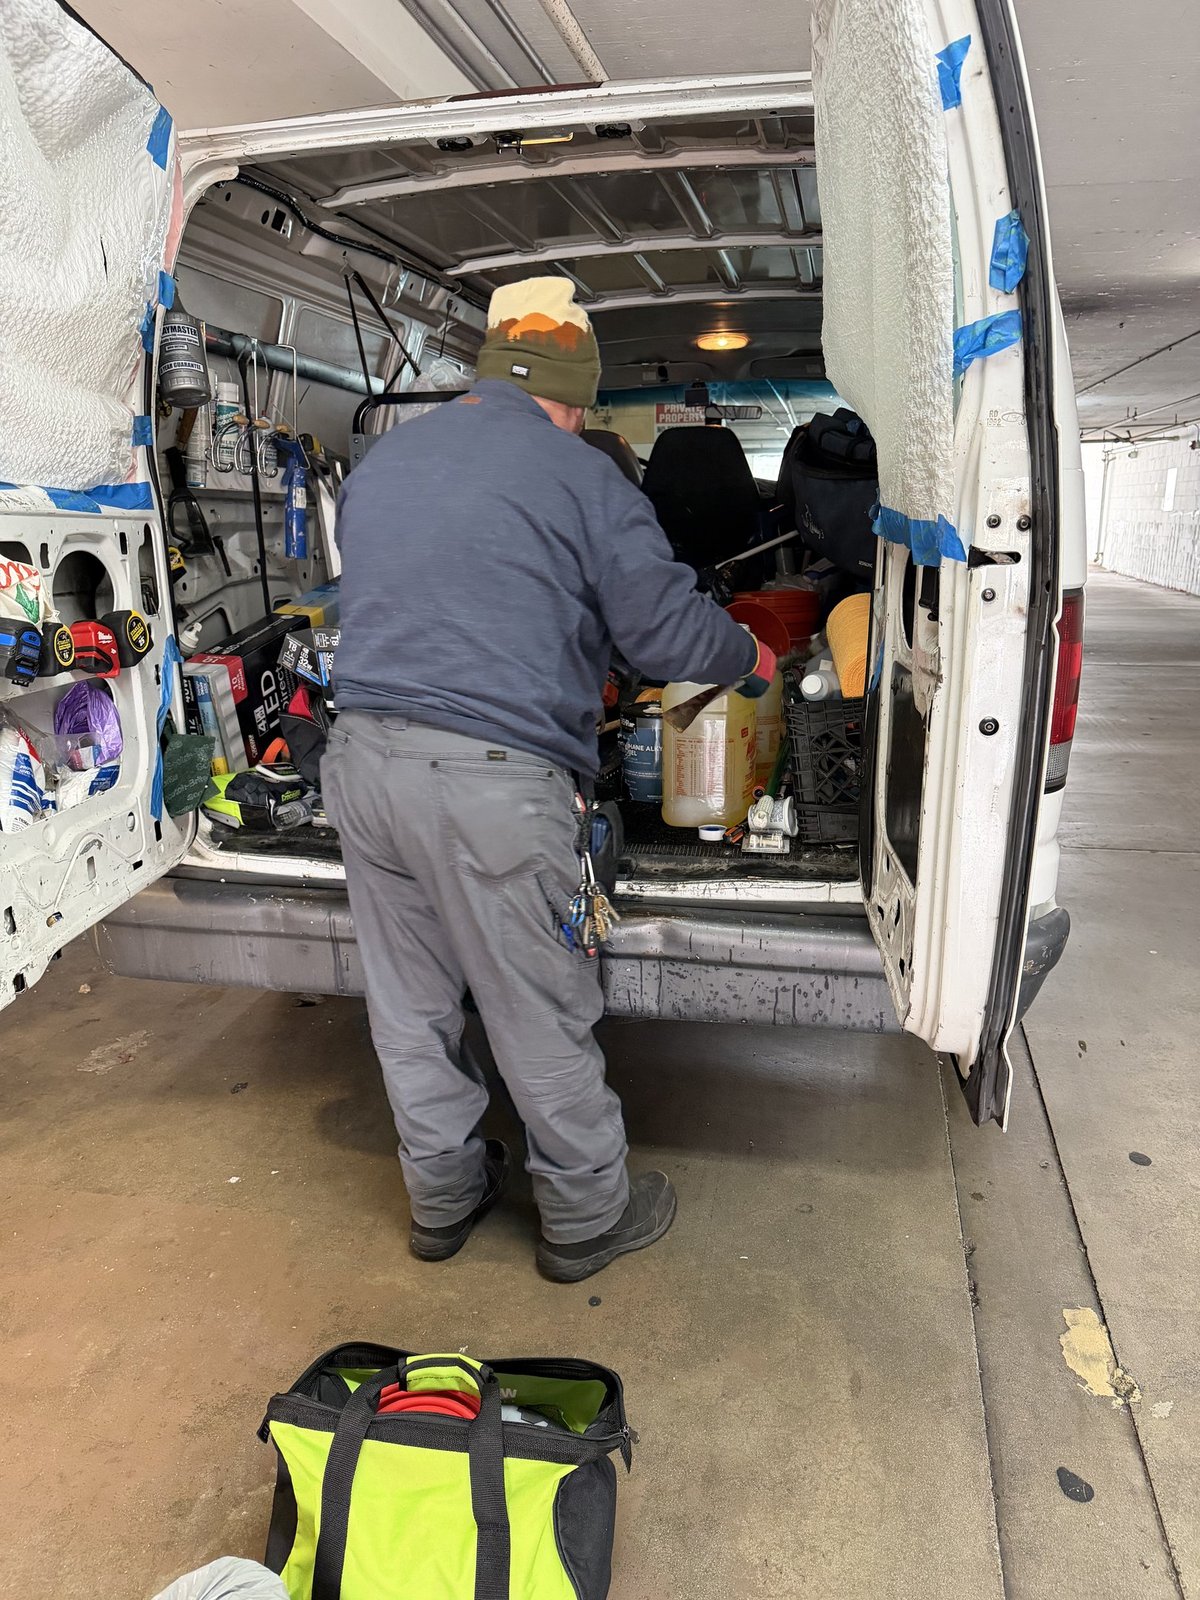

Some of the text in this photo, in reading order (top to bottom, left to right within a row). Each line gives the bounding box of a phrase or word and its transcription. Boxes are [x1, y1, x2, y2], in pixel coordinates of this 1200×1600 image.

[162, 325, 198, 336] AYMASTER
[664, 404, 704, 413] PRIVATE
[659, 413, 705, 423] PROPERTY
[289, 641, 297, 651] T8
[231, 676, 238, 690] 10
[260, 670, 281, 729] LED
